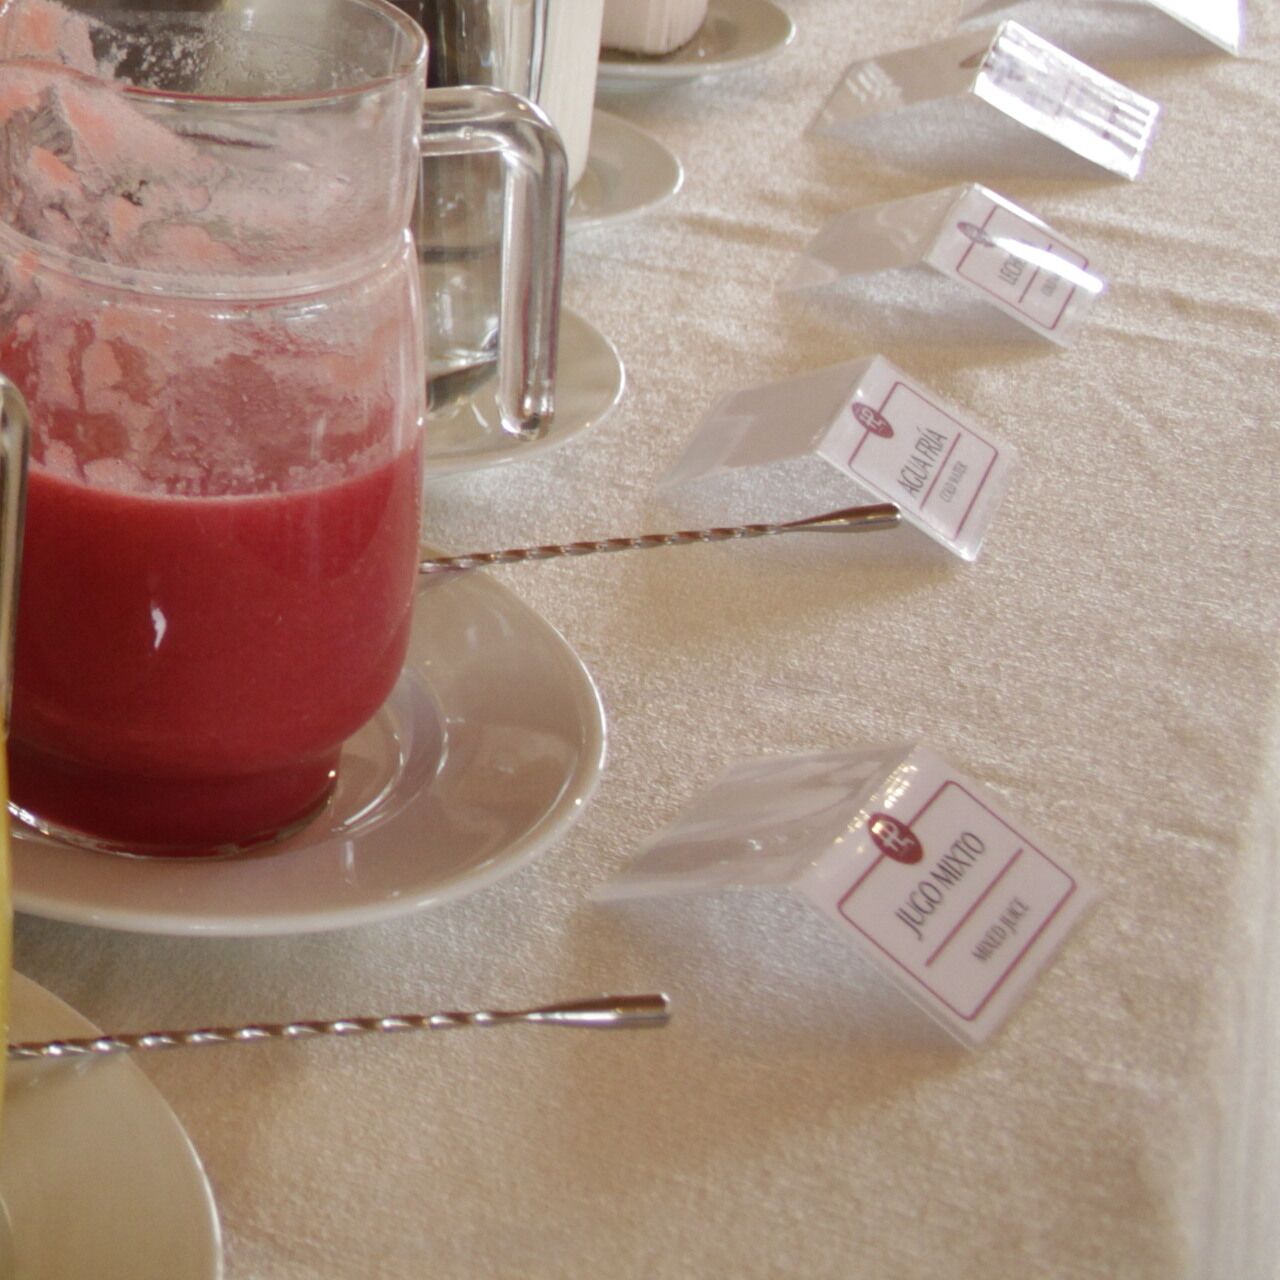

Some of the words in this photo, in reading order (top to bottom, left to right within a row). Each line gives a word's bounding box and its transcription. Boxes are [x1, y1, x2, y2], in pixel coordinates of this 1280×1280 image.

[998, 256, 1025, 284] LECH
[897, 456, 933, 496] AGUA
[895, 880, 941, 940] JUGO
[930, 831, 985, 887] MIXTO
